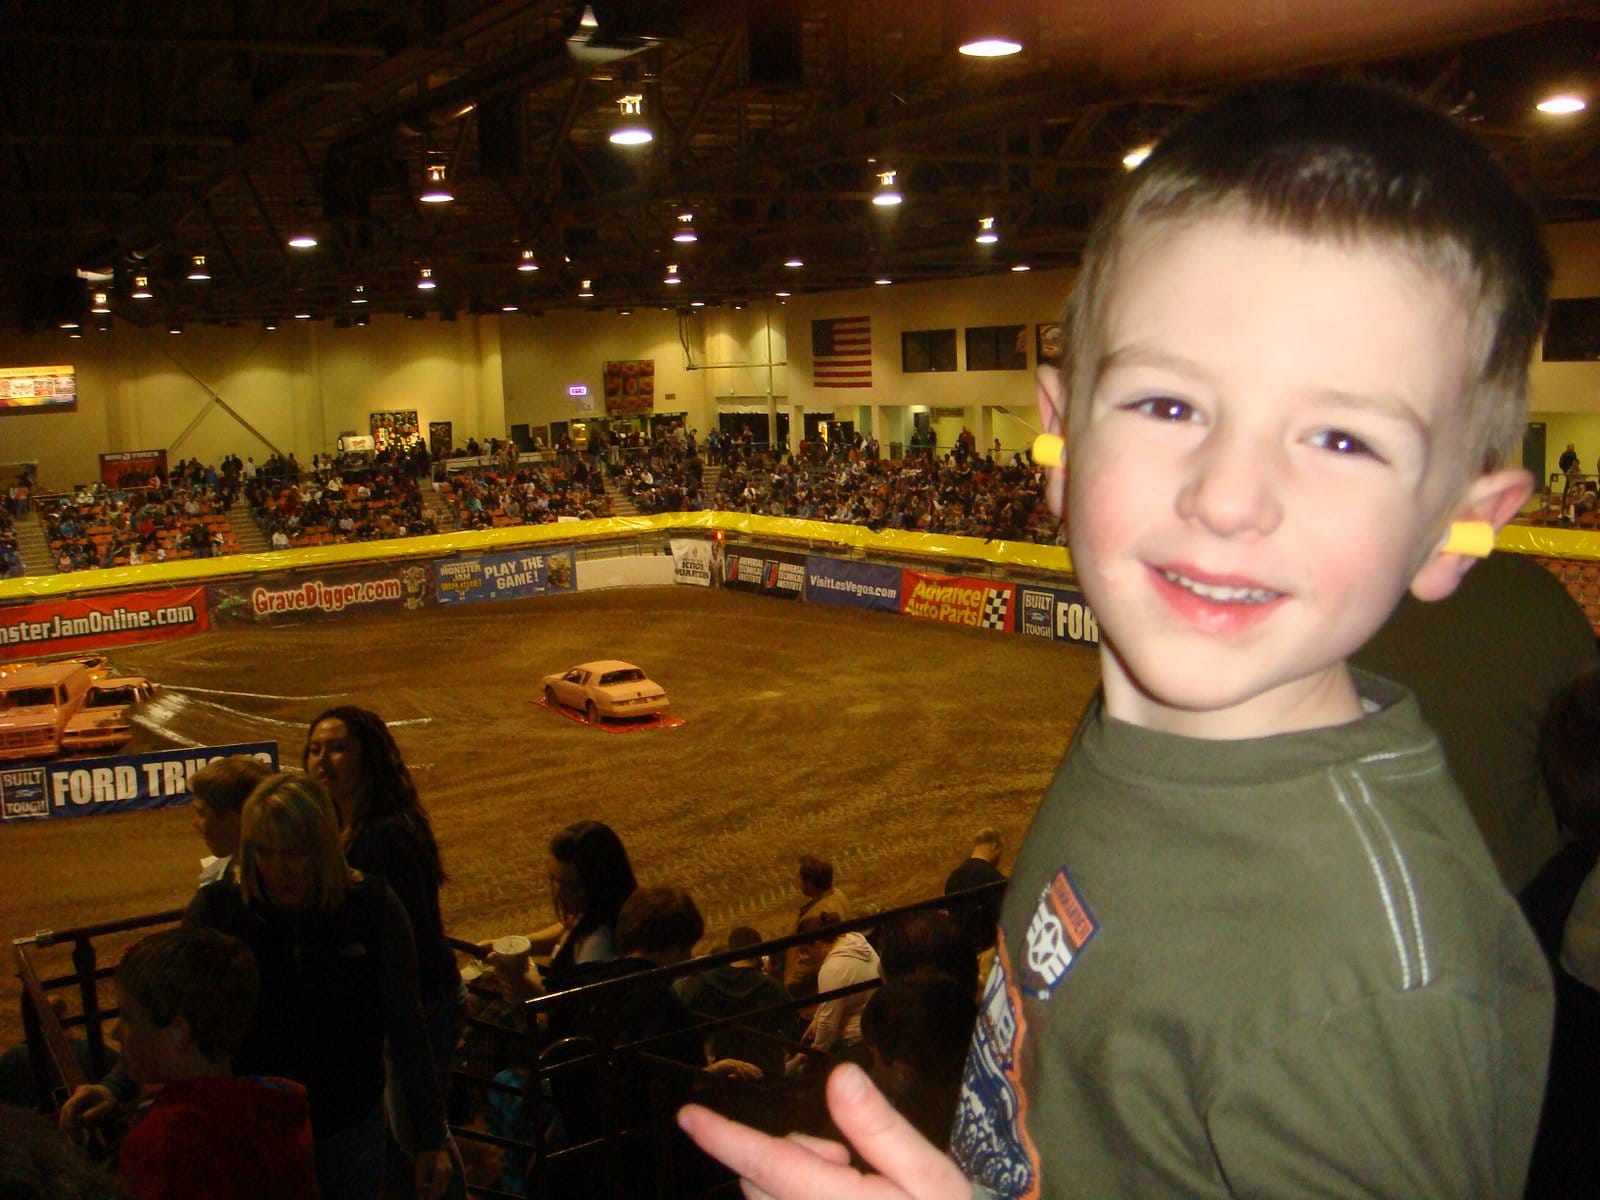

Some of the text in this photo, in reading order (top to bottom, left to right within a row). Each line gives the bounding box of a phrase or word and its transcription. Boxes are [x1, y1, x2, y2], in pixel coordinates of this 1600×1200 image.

[440, 563, 481, 576] MONSTER
[484, 561, 516, 579] PLAY
[520, 556, 544, 571] THE
[496, 570, 539, 590] GAME!
[810, 574, 897, 599] VisitLasVegas.com
[253, 579, 401, 615] GraveDigger.com
[911, 580, 981, 607] Advance
[1025, 594, 1051, 610] BUILT
[904, 598, 978, 626] Auto Parts
[1025, 624, 1050, 638] TOUGH
[2, 772, 42, 787] BUILT
[52, 765, 138, 806] FORD
[6, 800, 45, 815] TOUGH
